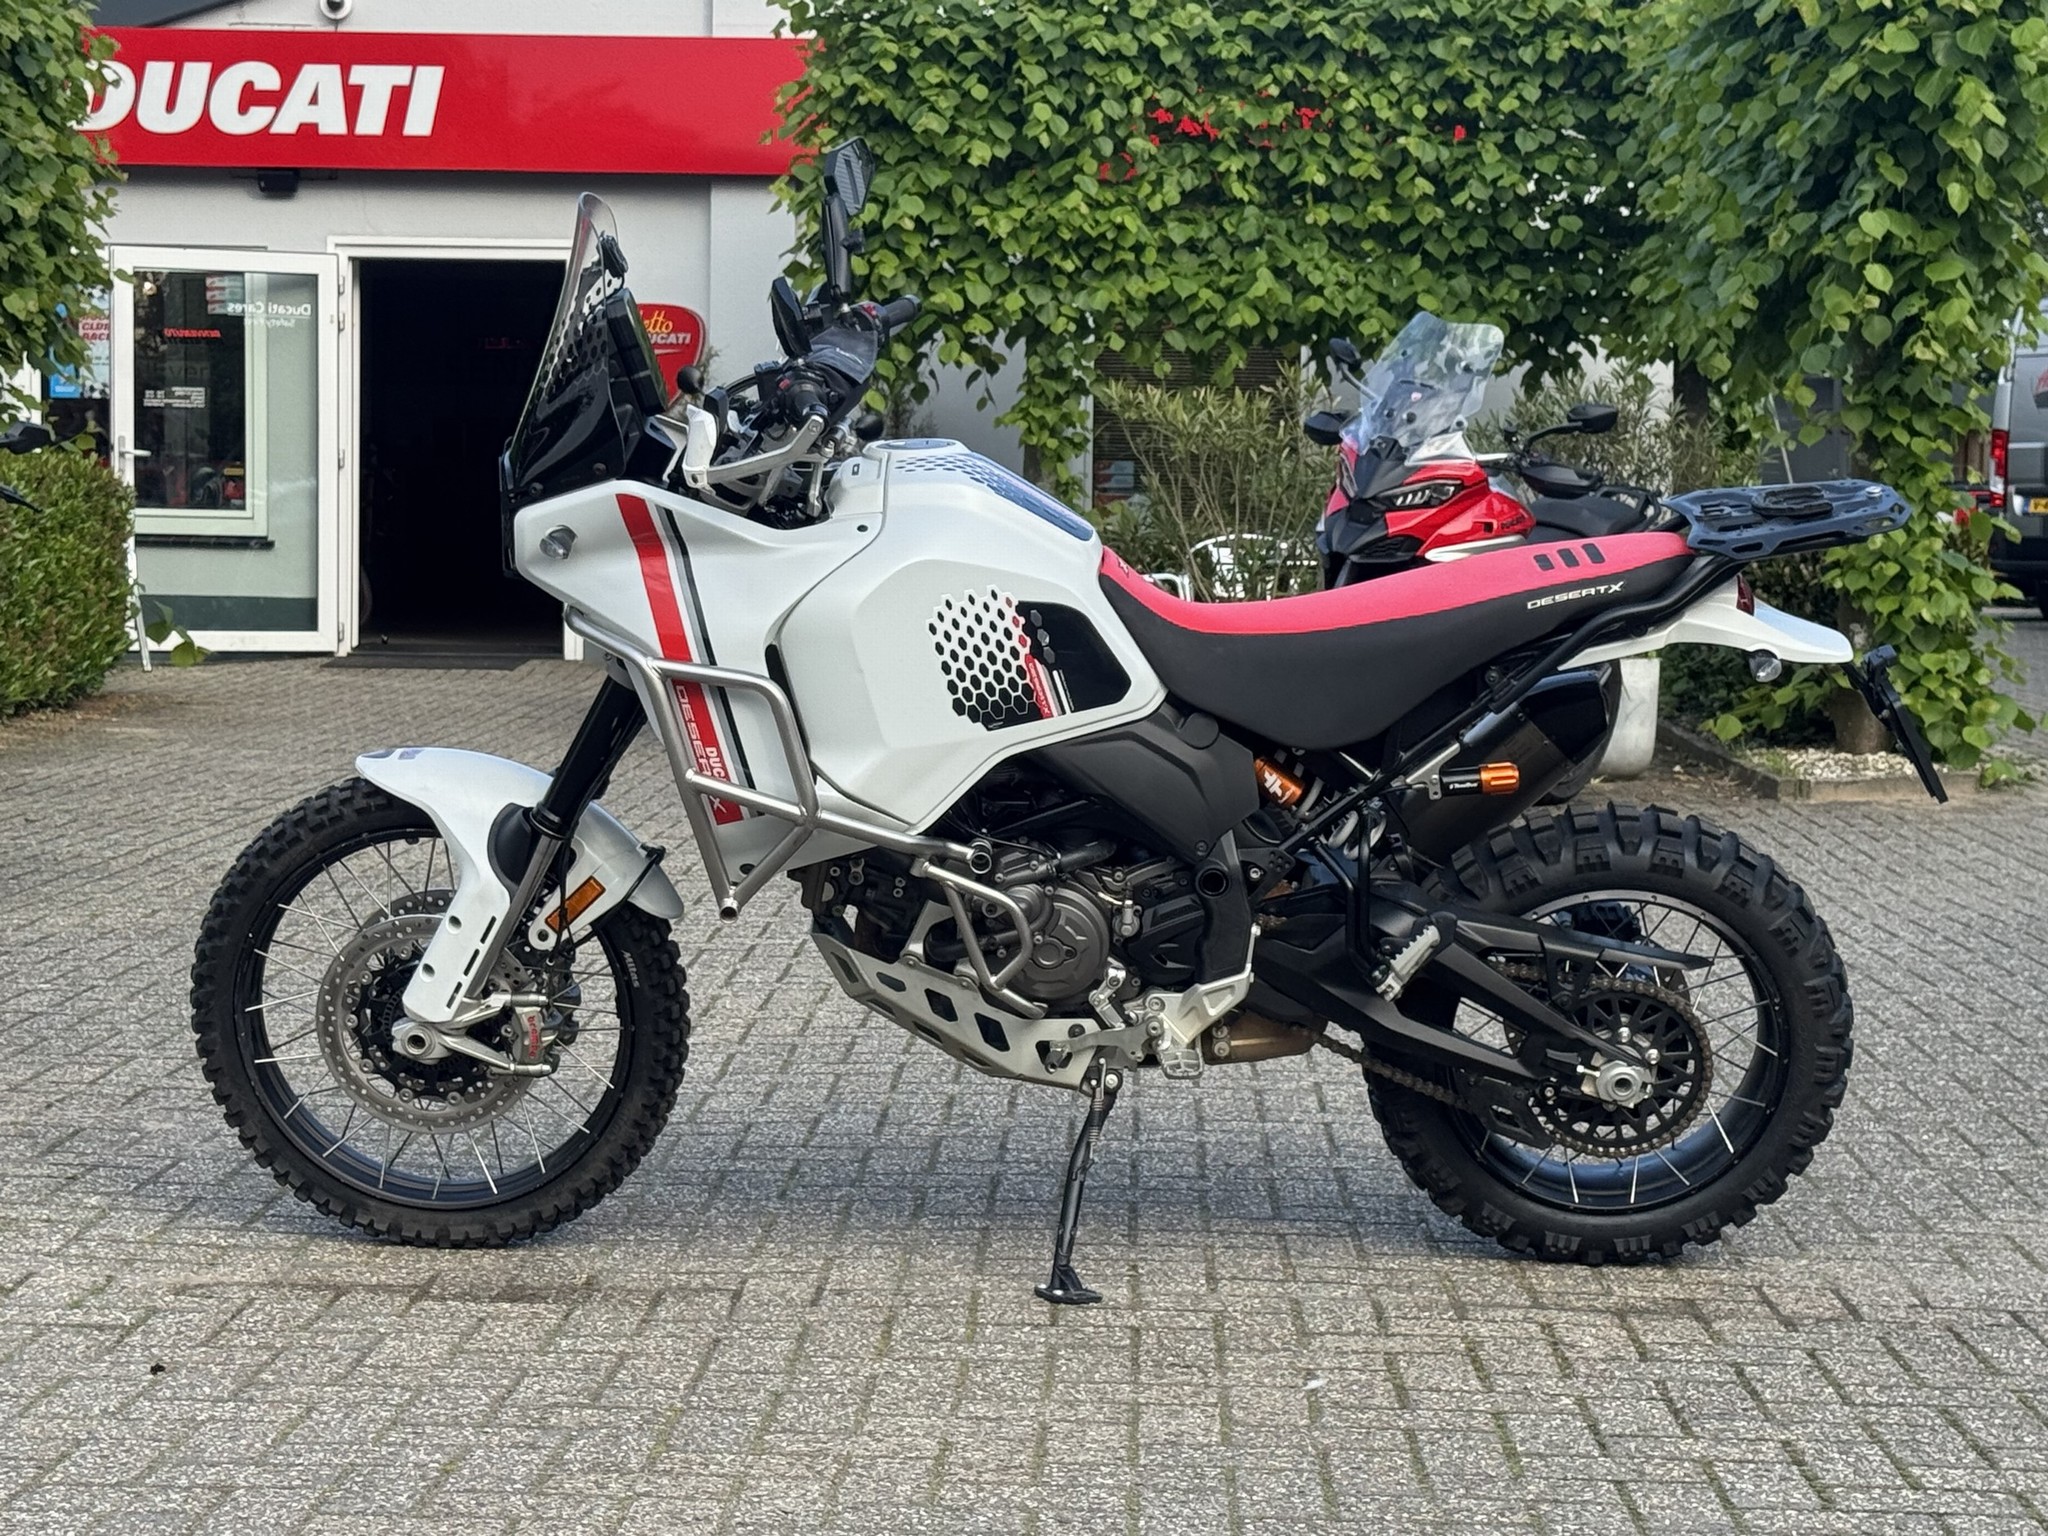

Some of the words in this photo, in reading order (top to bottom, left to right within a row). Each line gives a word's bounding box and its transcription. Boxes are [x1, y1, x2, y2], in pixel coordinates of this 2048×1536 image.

[69, 60, 445, 137] DUCATI
[1527, 580, 1625, 610] DESERTX
[676, 685, 728, 814] DESERX
[705, 746, 728, 782] DUC
